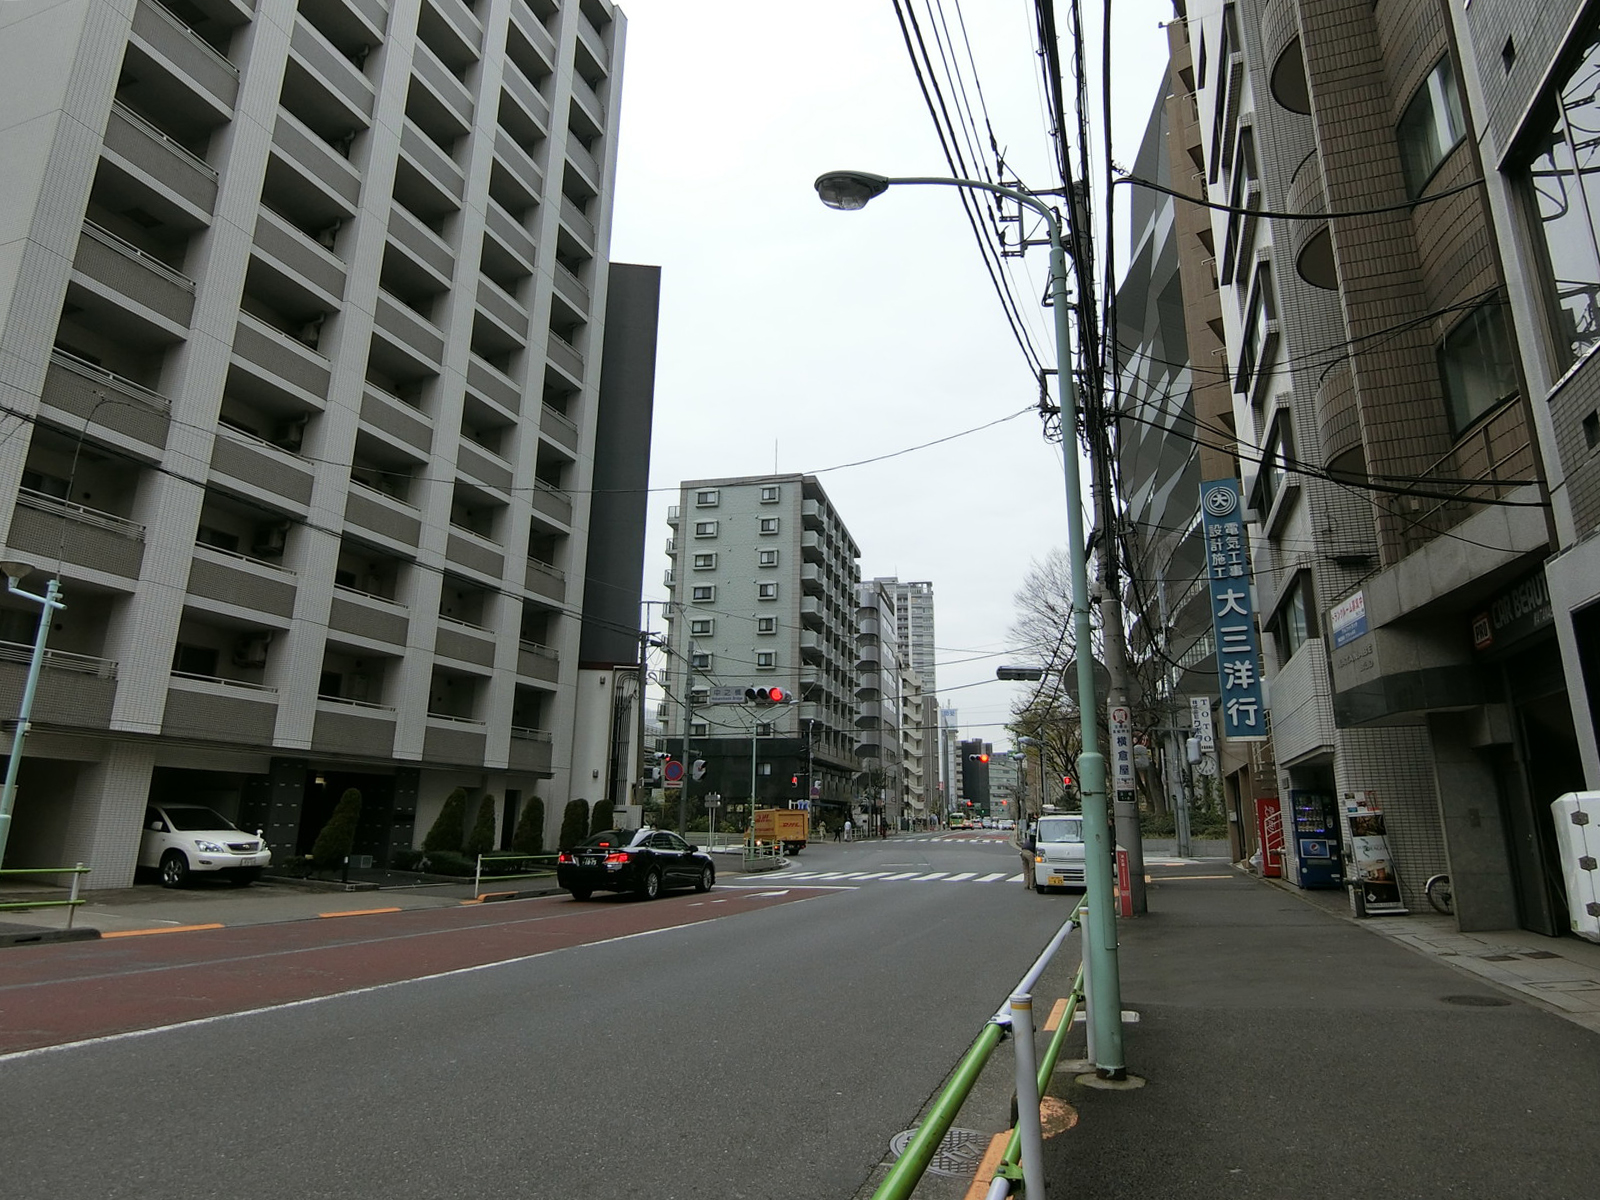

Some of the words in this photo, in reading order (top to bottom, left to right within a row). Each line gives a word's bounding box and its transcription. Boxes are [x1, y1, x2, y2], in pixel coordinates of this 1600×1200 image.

[1208, 525, 1227, 579] 設計施工
[1224, 522, 1244, 577] 電気工事
[1216, 588, 1258, 727] 大三洋行
[1200, 699, 1212, 742] TOTO
[1117, 736, 1130, 775] 横倉屋
